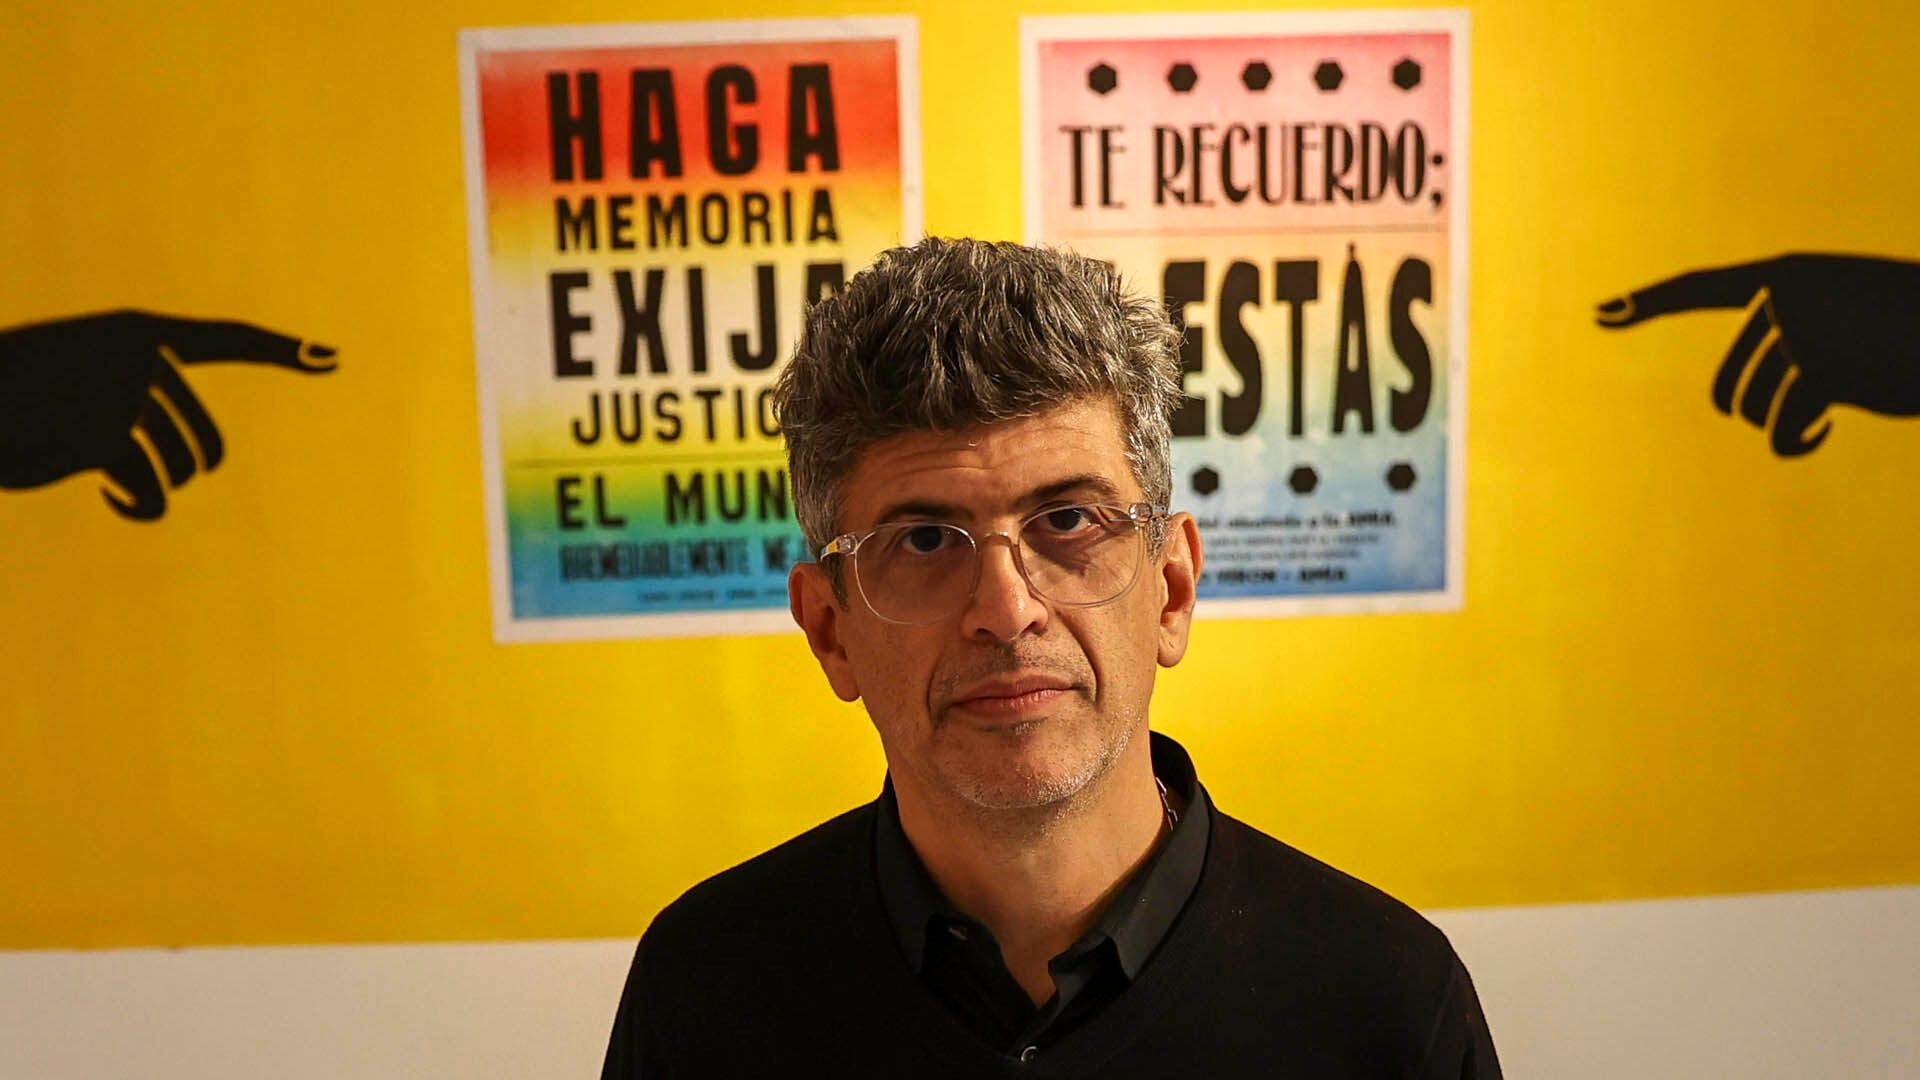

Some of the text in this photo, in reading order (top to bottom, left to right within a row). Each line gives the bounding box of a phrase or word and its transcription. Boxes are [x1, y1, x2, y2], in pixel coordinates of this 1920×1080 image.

[547, 63, 840, 183] HAGA
[1060, 121, 1444, 210] TE RECUERDO;
[556, 187, 839, 252] MEMORIA
[556, 468, 790, 531] EL MUN
